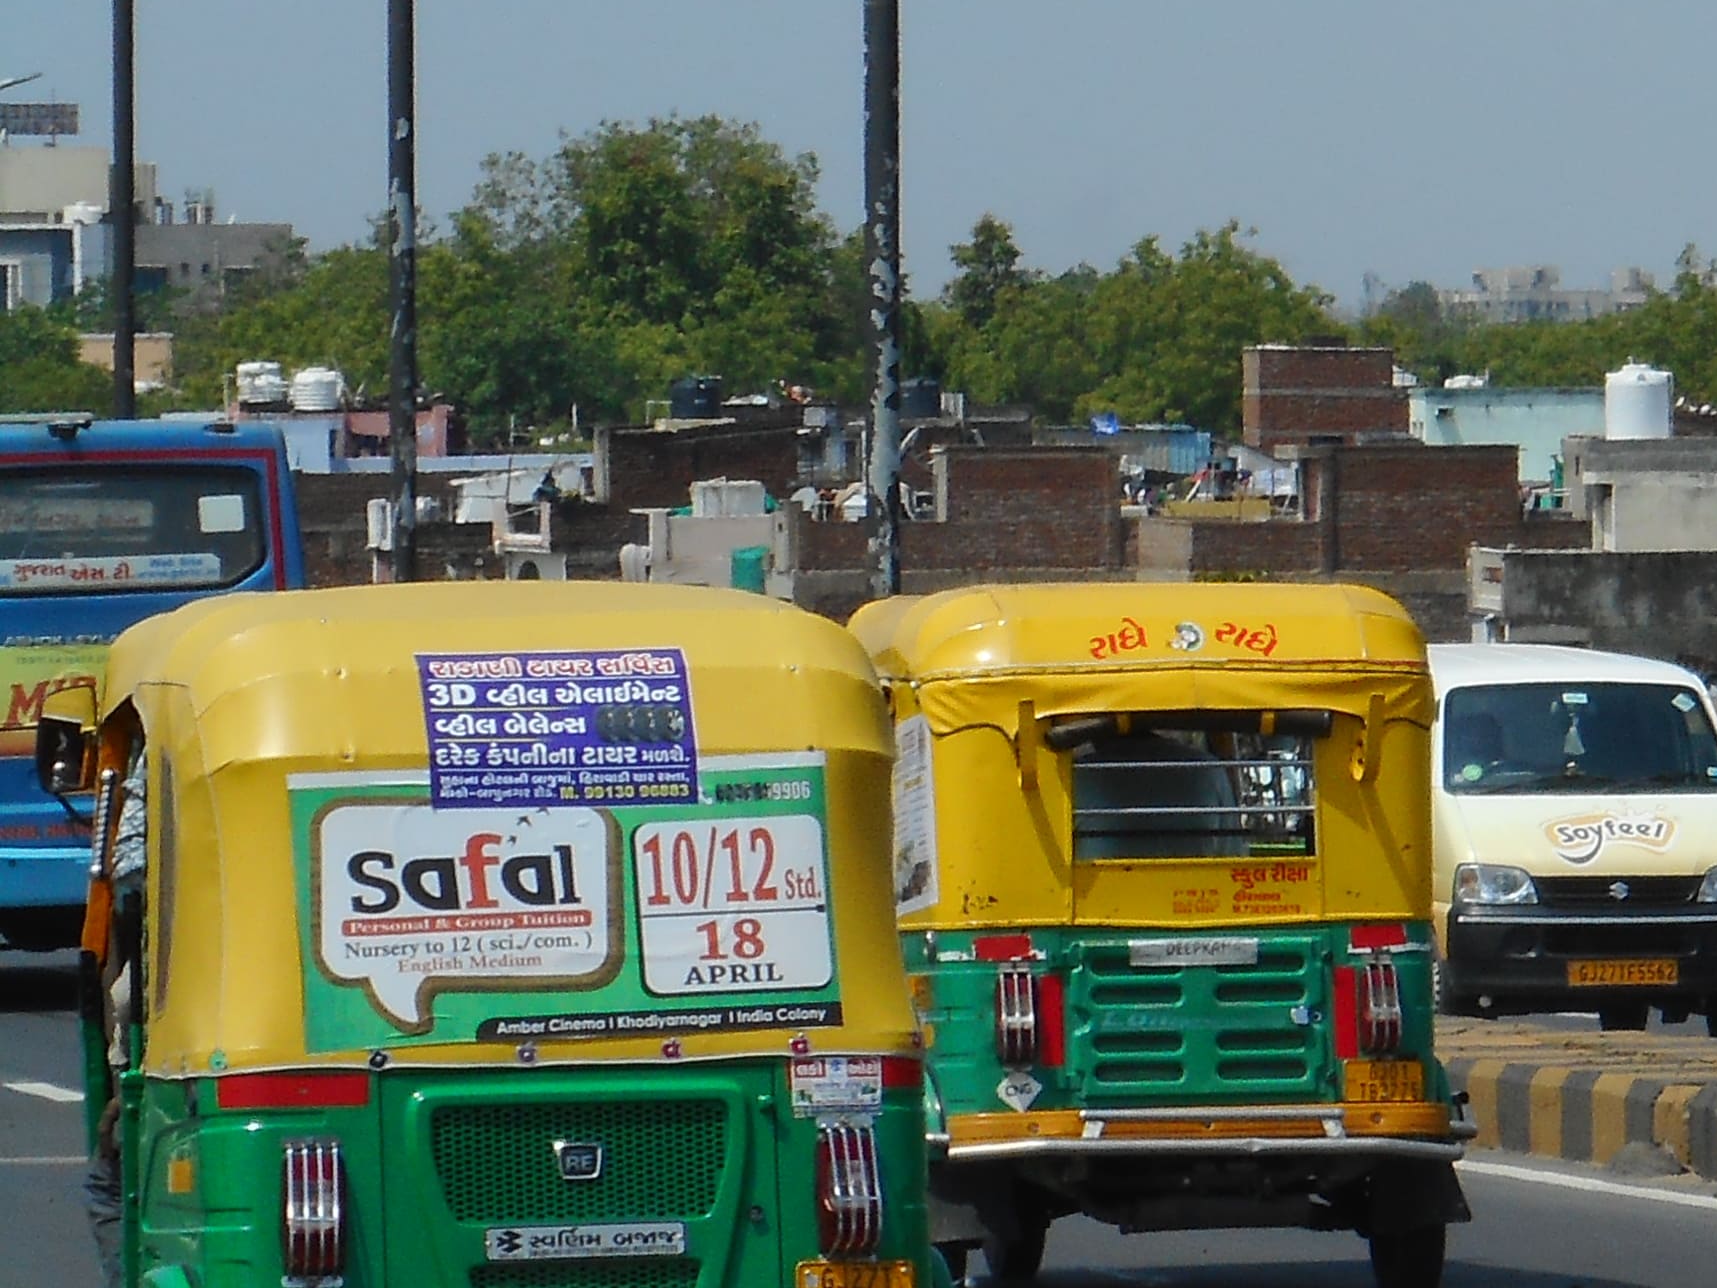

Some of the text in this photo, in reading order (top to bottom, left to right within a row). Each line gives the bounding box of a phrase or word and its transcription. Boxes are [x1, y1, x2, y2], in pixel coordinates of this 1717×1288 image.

[1089, 617, 1279, 660] રાધે રાધે
[527, 657, 593, 677] ટાયર
[428, 684, 477, 706] 3D
[486, 683, 549, 706] વ્હીલ
[435, 712, 587, 736] વ્હીલ બેલેન્સ
[434, 743, 481, 767] દરેક
[486, 741, 576, 766] કંપનીના
[582, 744, 639, 764] ટાયર
[1556, 820, 1665, 864] Soyfeel
[346, 833, 582, 915] Safal
[642, 826, 822, 910] 10/12 Std.
[349, 918, 430, 934] Personal
[455, 915, 514, 930] Group
[521, 912, 586, 927] Tuition
[344, 940, 420, 960] Nursery
[426, 940, 444, 954] to
[451, 936, 471, 952] 12
[696, 918, 765, 961] 18
[399, 954, 542, 973] English Medium
[684, 962, 784, 986] APRIL
[497, 1020, 546, 1035] Amber
[549, 1018, 606, 1032] Cinema
[737, 1009, 774, 1024] India
[776, 1007, 827, 1025] Colony
